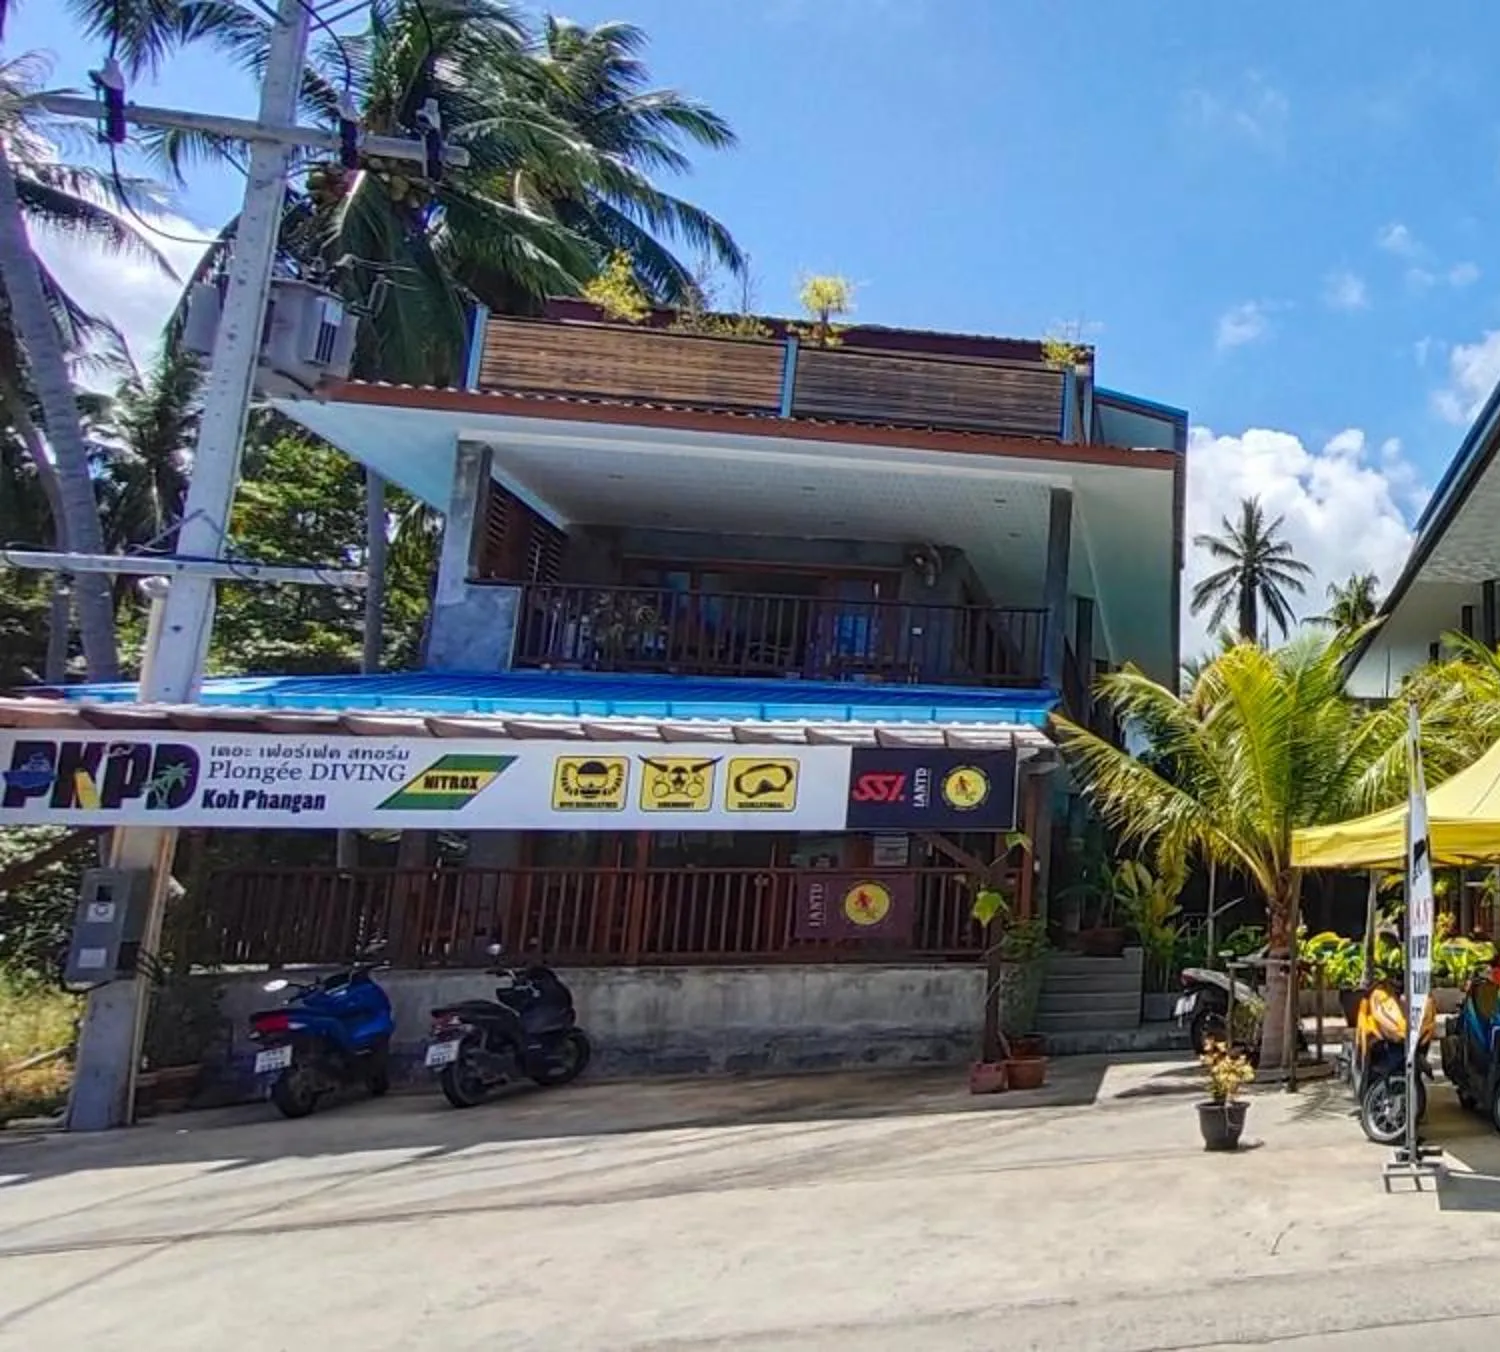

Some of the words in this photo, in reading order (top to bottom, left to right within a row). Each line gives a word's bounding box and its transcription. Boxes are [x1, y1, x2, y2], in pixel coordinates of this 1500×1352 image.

[2, 741, 199, 811] PKPD
[207, 760, 302, 785] Plongée
[309, 763, 407, 783] DIVING
[423, 776, 480, 790] NITROX
[201, 788, 240, 810] Koh
[242, 790, 327, 814] Phangan
